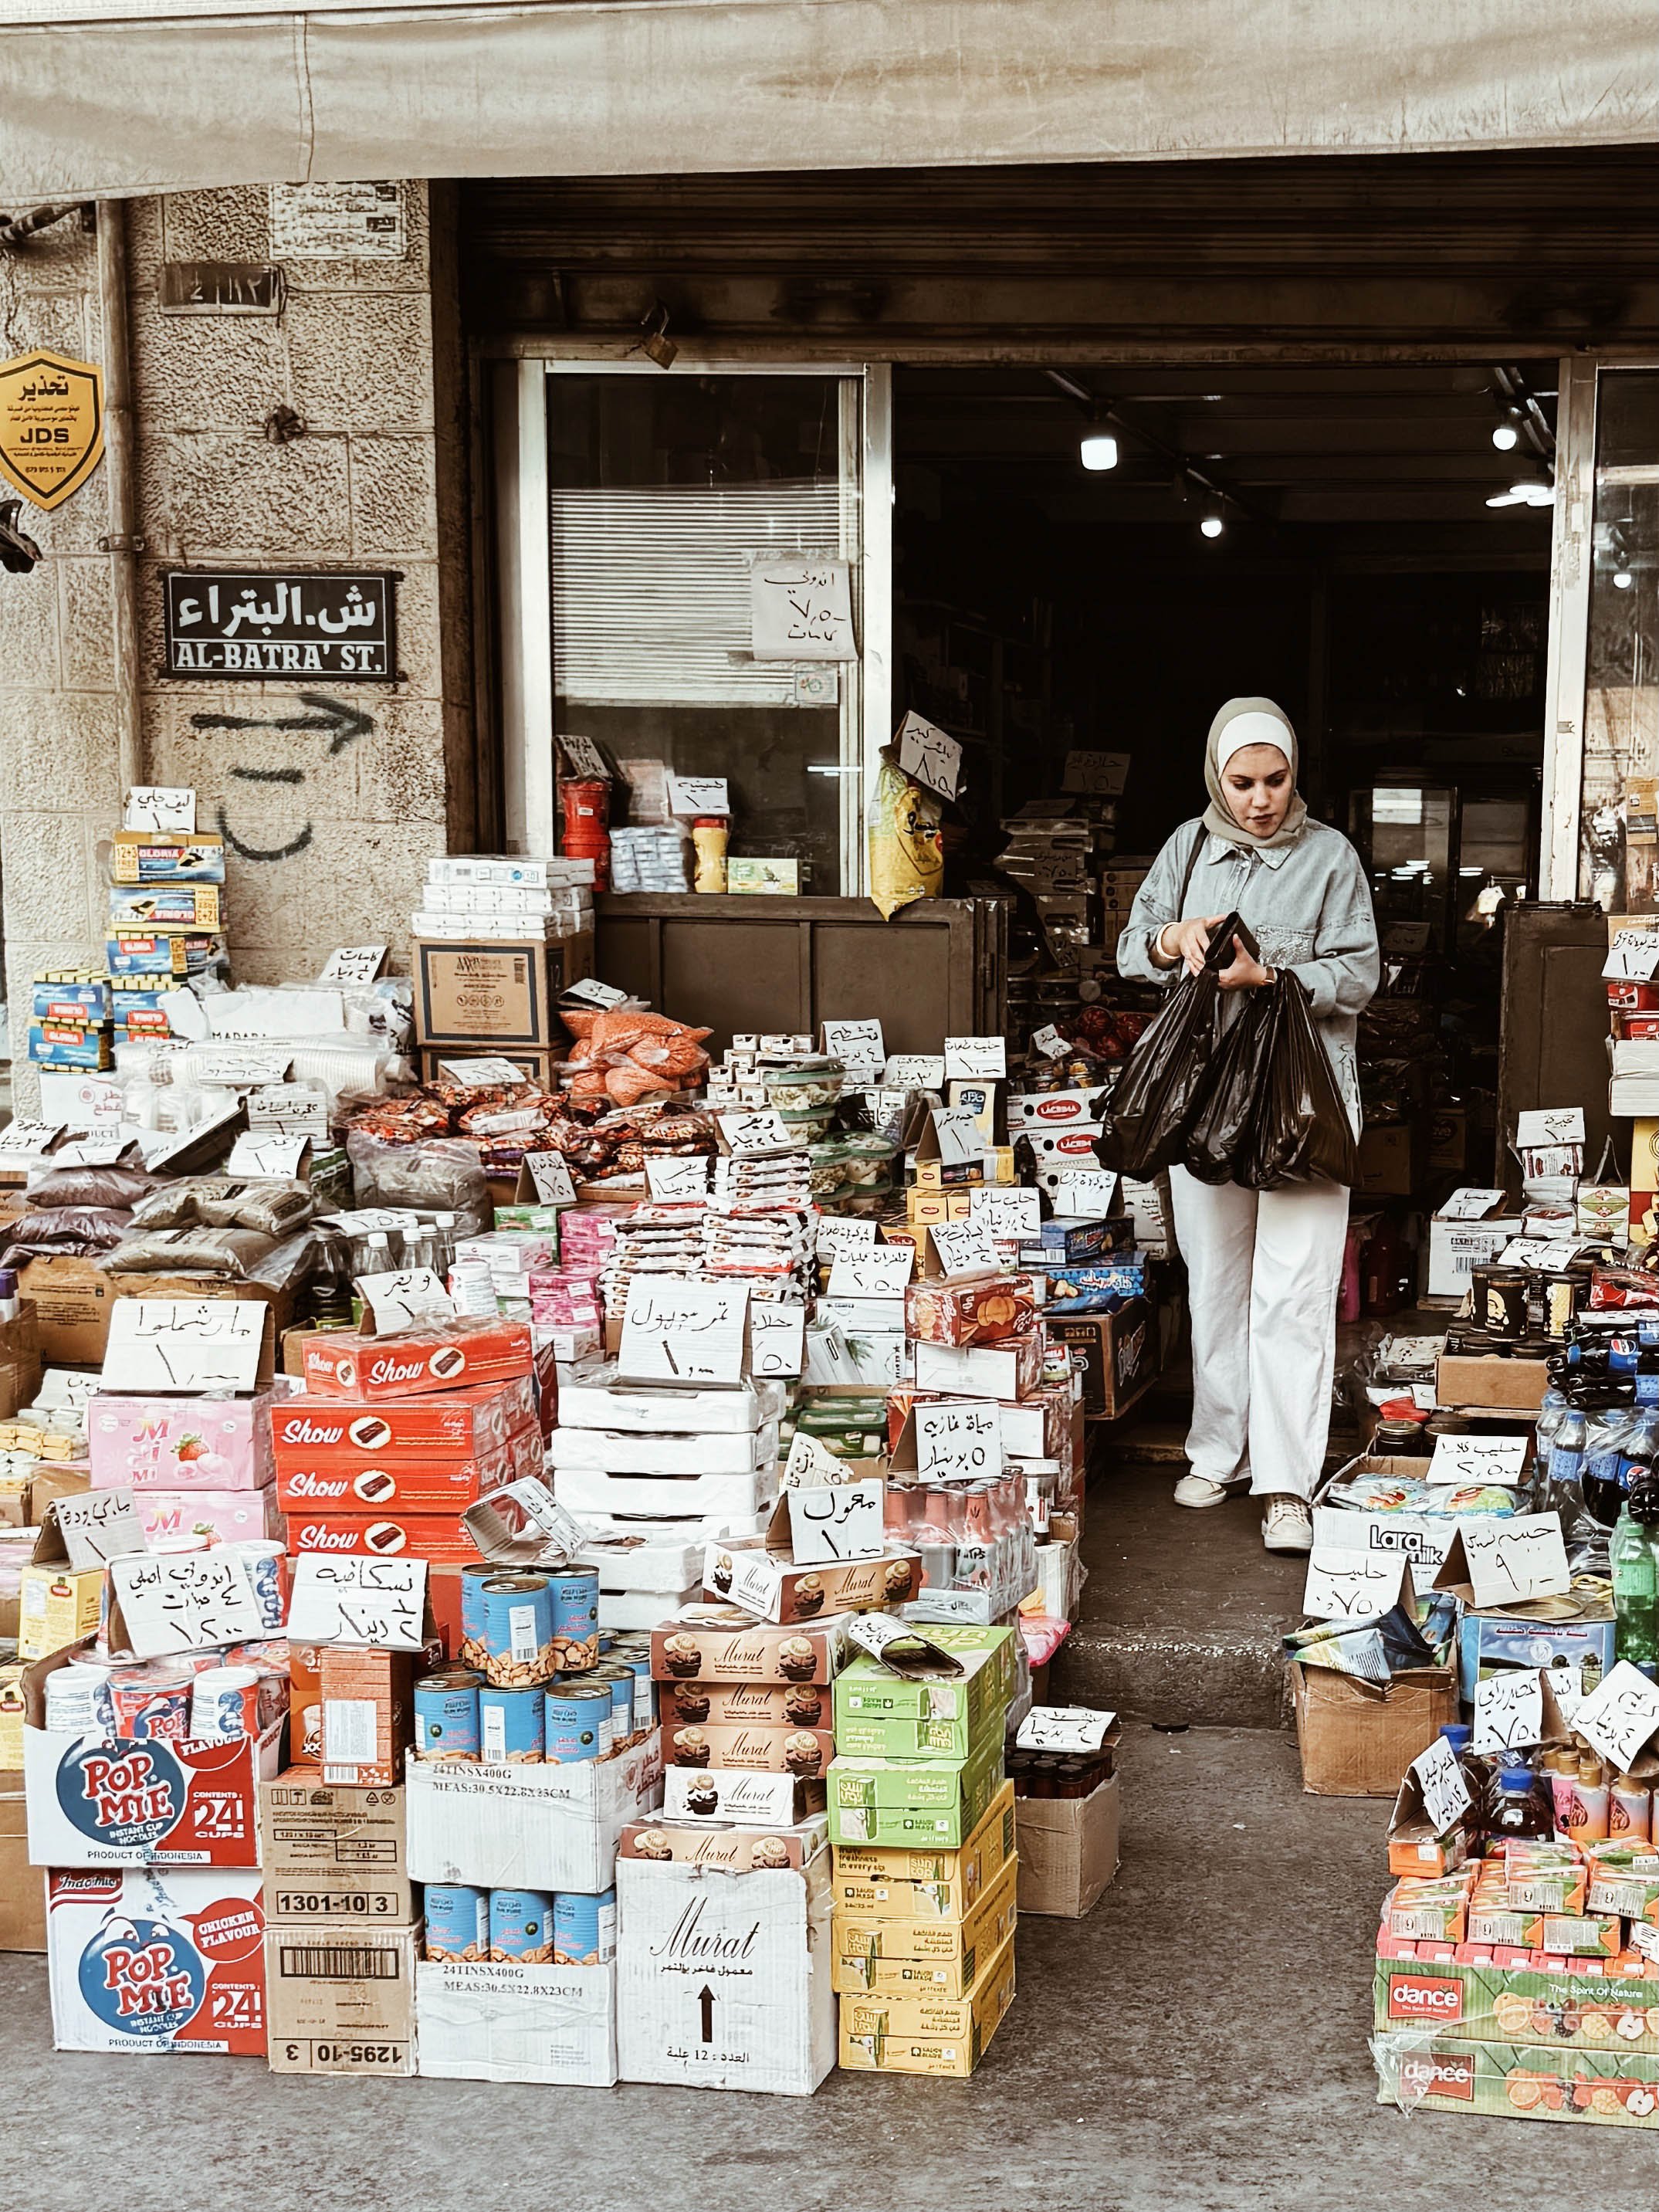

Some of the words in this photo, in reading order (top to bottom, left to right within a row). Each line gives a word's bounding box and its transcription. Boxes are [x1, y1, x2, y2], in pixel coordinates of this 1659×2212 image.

[19, 375, 69, 401] تحذير
[20, 428, 69, 444] JDS
[176, 643, 330, 670] AL-BATRA'
[340, 645, 382, 672] ST.
[367, 1358, 426, 1385] Show
[281, 1418, 345, 1445] Show
[285, 1473, 349, 1499] Show
[296, 1525, 360, 1549] Show
[1370, 1525, 1423, 1550] Lara
[835, 1567, 876, 1596] Murat
[713, 1637, 765, 1662] Murat
[721, 1682, 773, 1707] Murat
[721, 1732, 770, 1757] Murat
[80, 1753, 153, 1800] POP
[721, 1777, 776, 1802] Murat
[95, 1783, 174, 1827] MIE
[86, 1850, 134, 1861] PRODUCT
[684, 1835, 736, 1862] Murat
[59, 1874, 117, 1890] Indomie
[280, 1895, 367, 1912] 1301-10
[374, 1895, 388, 1912] 3
[198, 1910, 256, 1936] CHICKEN
[200, 1922, 262, 1949] FLAVOUR
[649, 1895, 761, 1960] Murat
[103, 1945, 172, 1990] POP
[117, 1974, 193, 2016] MIE
[1393, 1983, 1459, 2008] dance
[108, 2038, 154, 2048] PRODUCT
[693, 2050, 709, 2061] 12
